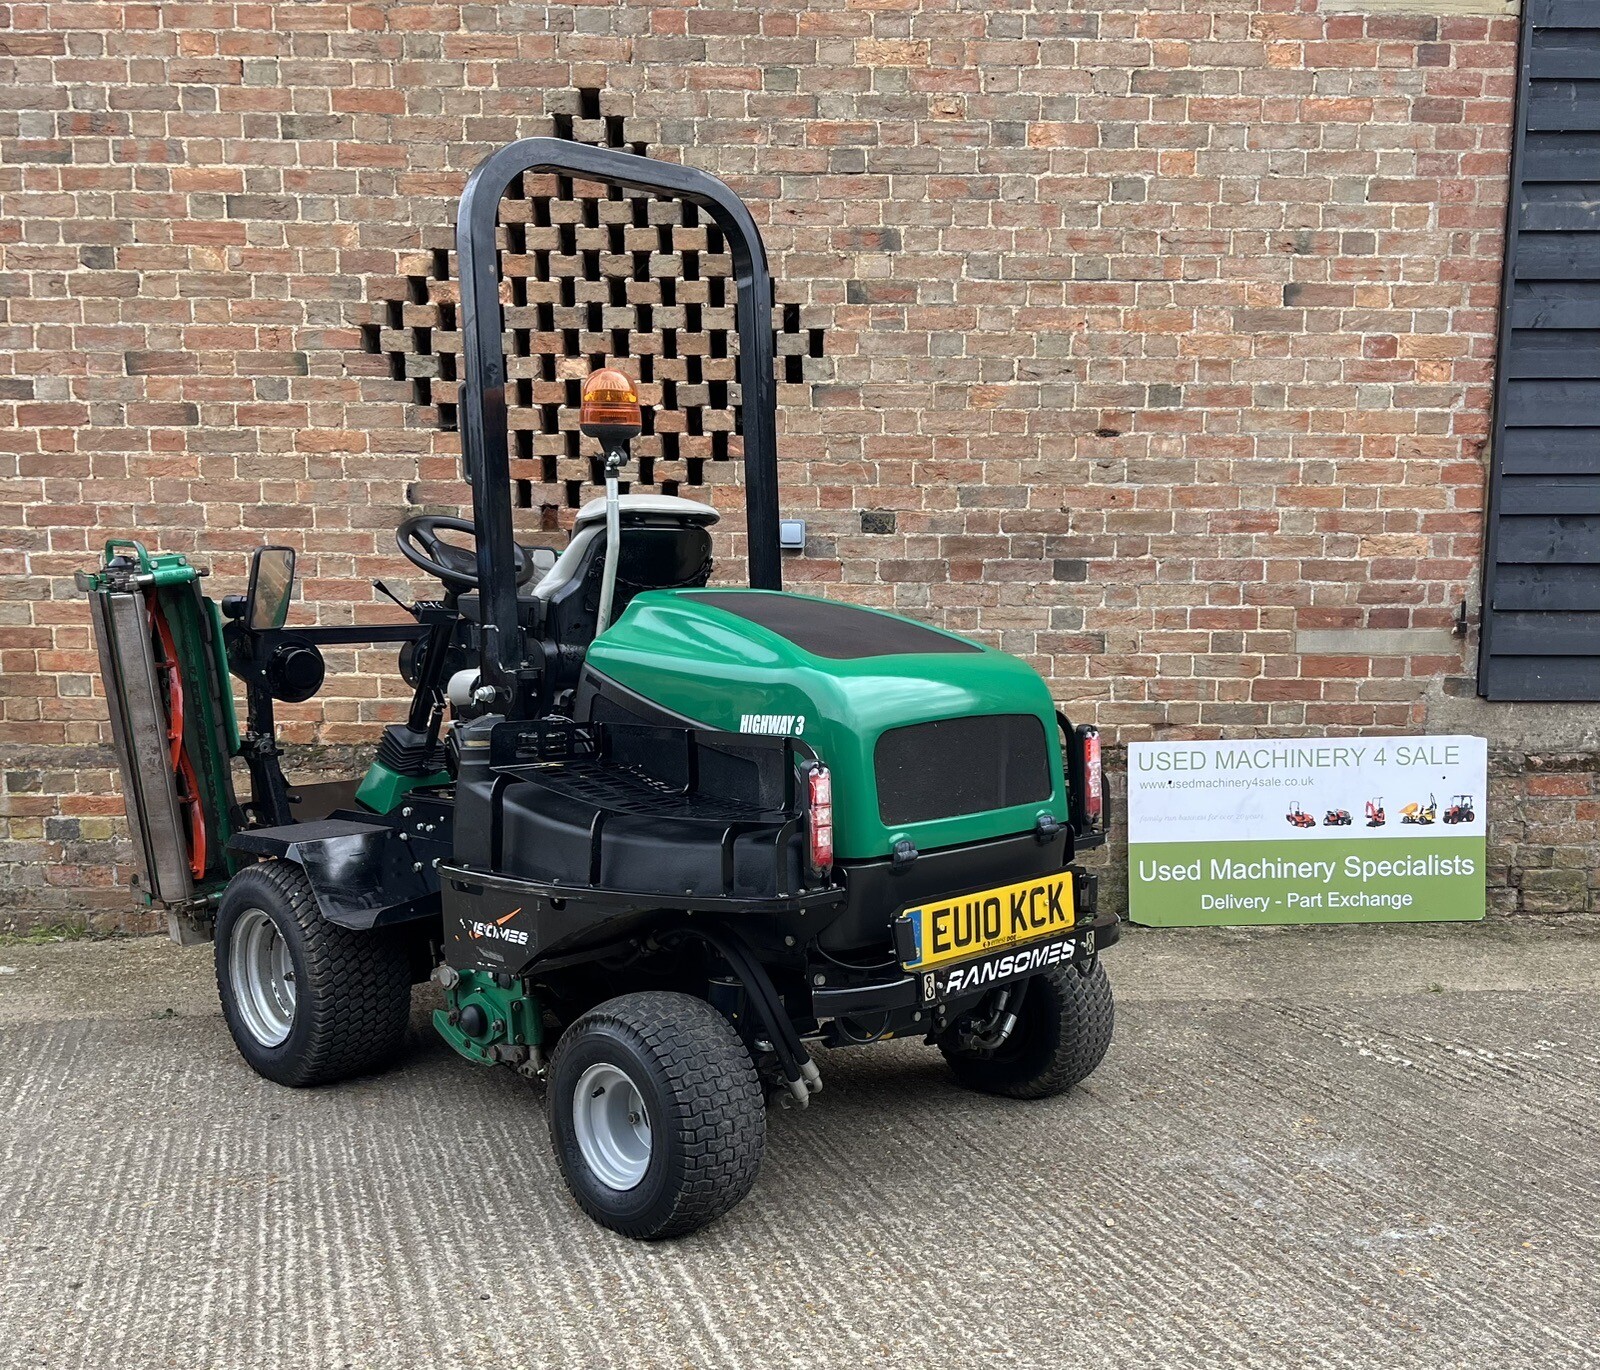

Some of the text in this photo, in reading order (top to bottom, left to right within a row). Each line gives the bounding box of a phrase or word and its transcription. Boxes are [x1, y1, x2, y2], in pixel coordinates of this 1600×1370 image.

[740, 714, 805, 736] HIGHWAY 3
[1138, 745, 1460, 771] USED MACHINERY 4 SALE
[1139, 776, 1314, 790] www.usedmachinery4sale.co.uk
[1139, 854, 1475, 883] Used Machinery Specialists
[1201, 894, 1270, 913] Delivery
[1287, 892, 1323, 908] Part
[1328, 891, 1413, 909] Exchange
[932, 881, 1065, 954] EU10 KCK
[946, 938, 1076, 994] RANSOMES
